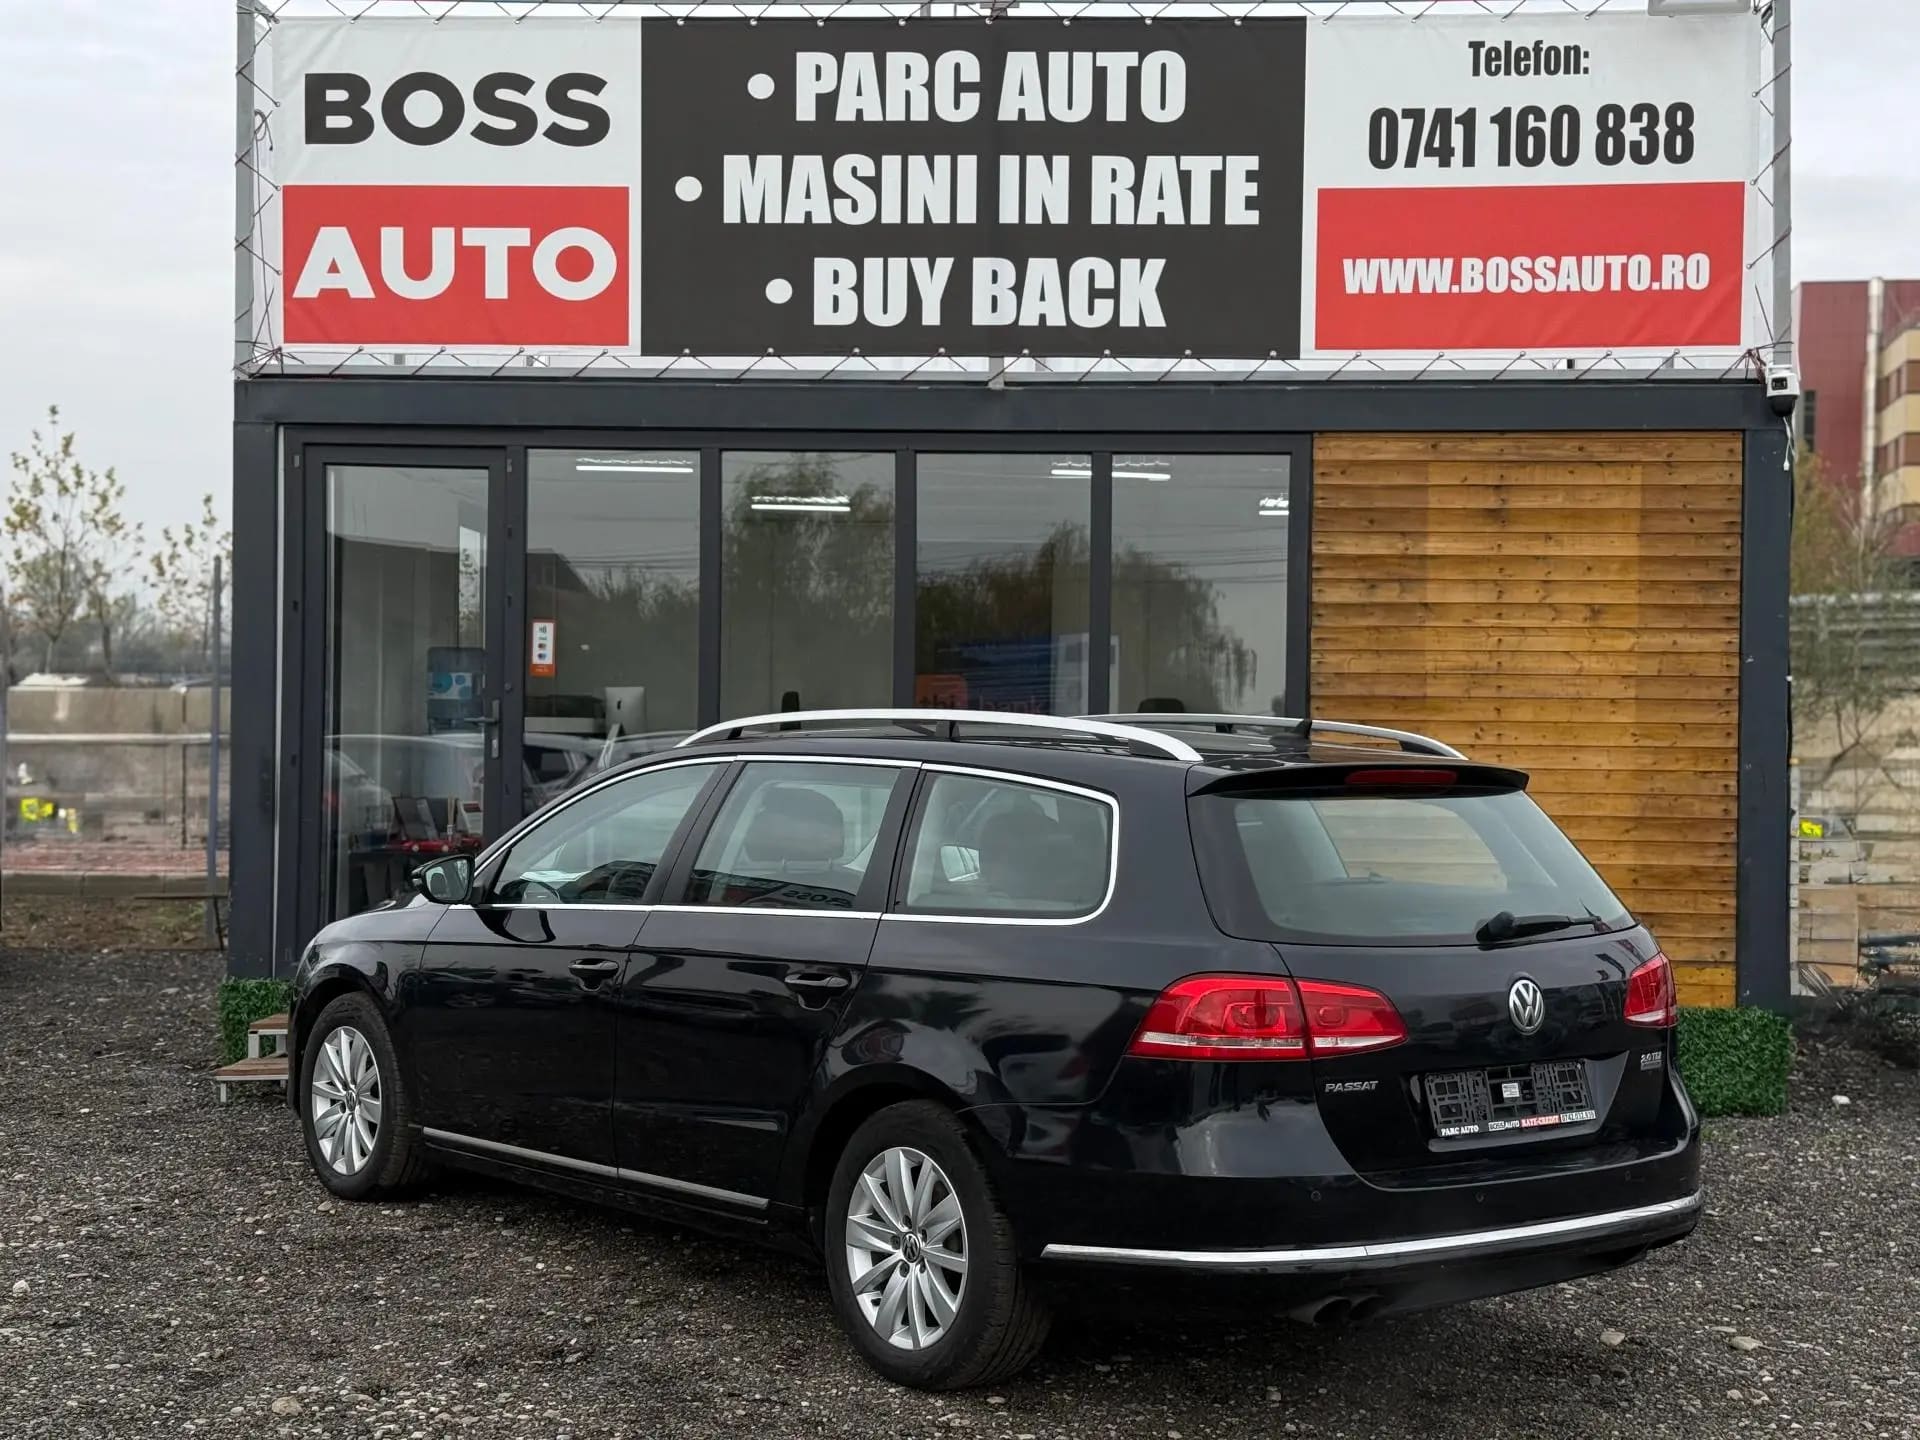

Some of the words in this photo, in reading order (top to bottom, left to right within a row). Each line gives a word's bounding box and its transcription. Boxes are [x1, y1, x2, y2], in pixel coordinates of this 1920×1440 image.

[795, 49, 981, 123] PARC
[998, 50, 1187, 123] AUTO
[1469, 39, 1590, 77] Telefon:
[304, 71, 611, 147] BOSS
[1368, 107, 1477, 170] 0741
[1489, 104, 1581, 168] 160
[1595, 101, 1695, 166] 838
[723, 153, 978, 226] MASINI
[998, 154, 1070, 225] IN
[1090, 155, 1260, 225] RATE
[292, 226, 618, 301] AUTO
[813, 257, 955, 327] BUY
[971, 256, 1167, 328] BACK
[1342, 252, 1710, 294] WWW.BOSSAUTO.RO
[1324, 1080, 1379, 1093] PASSAT
[1441, 1127, 1459, 1136] PARC
[1461, 1125, 1479, 1134] AUTO
